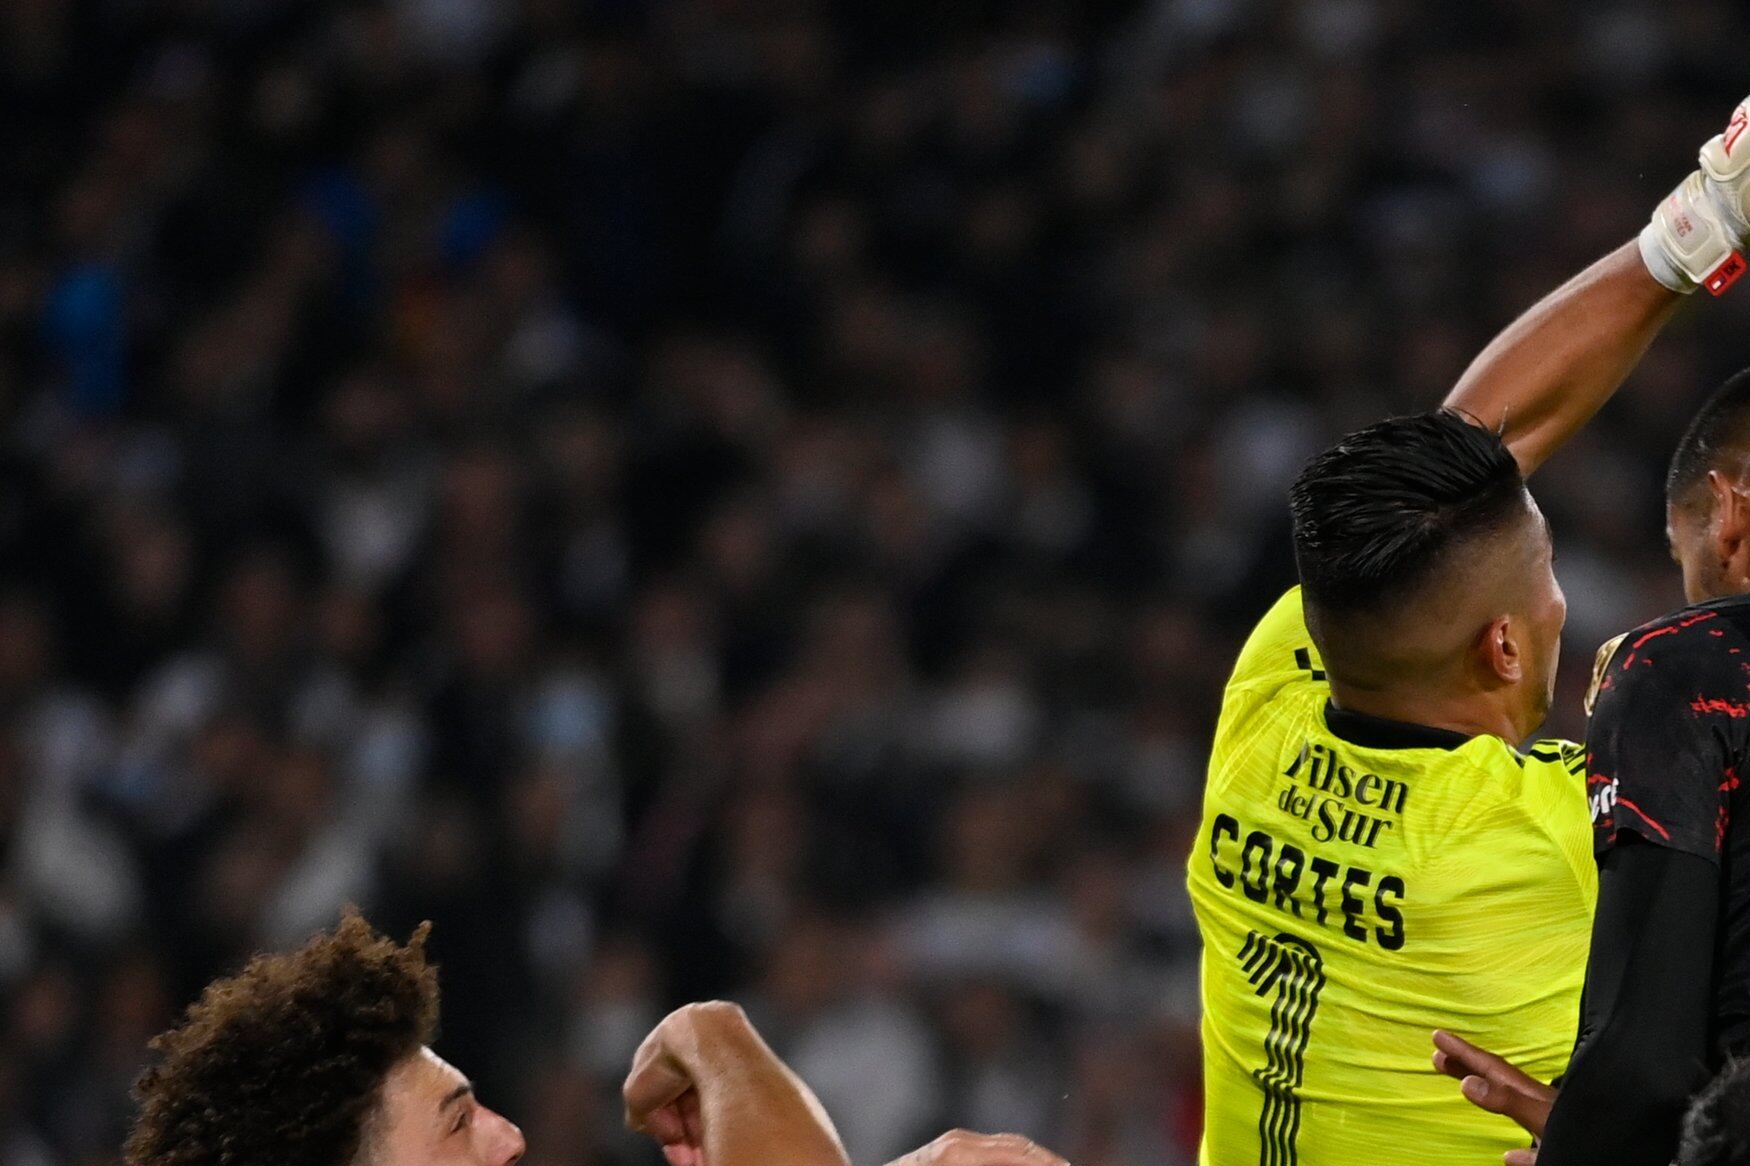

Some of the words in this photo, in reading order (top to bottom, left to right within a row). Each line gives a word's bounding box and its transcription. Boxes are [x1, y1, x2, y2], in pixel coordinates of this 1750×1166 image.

[1278, 784, 1316, 820] del
[1311, 798, 1393, 850] Sur
[1210, 812, 1406, 951] CORTES
